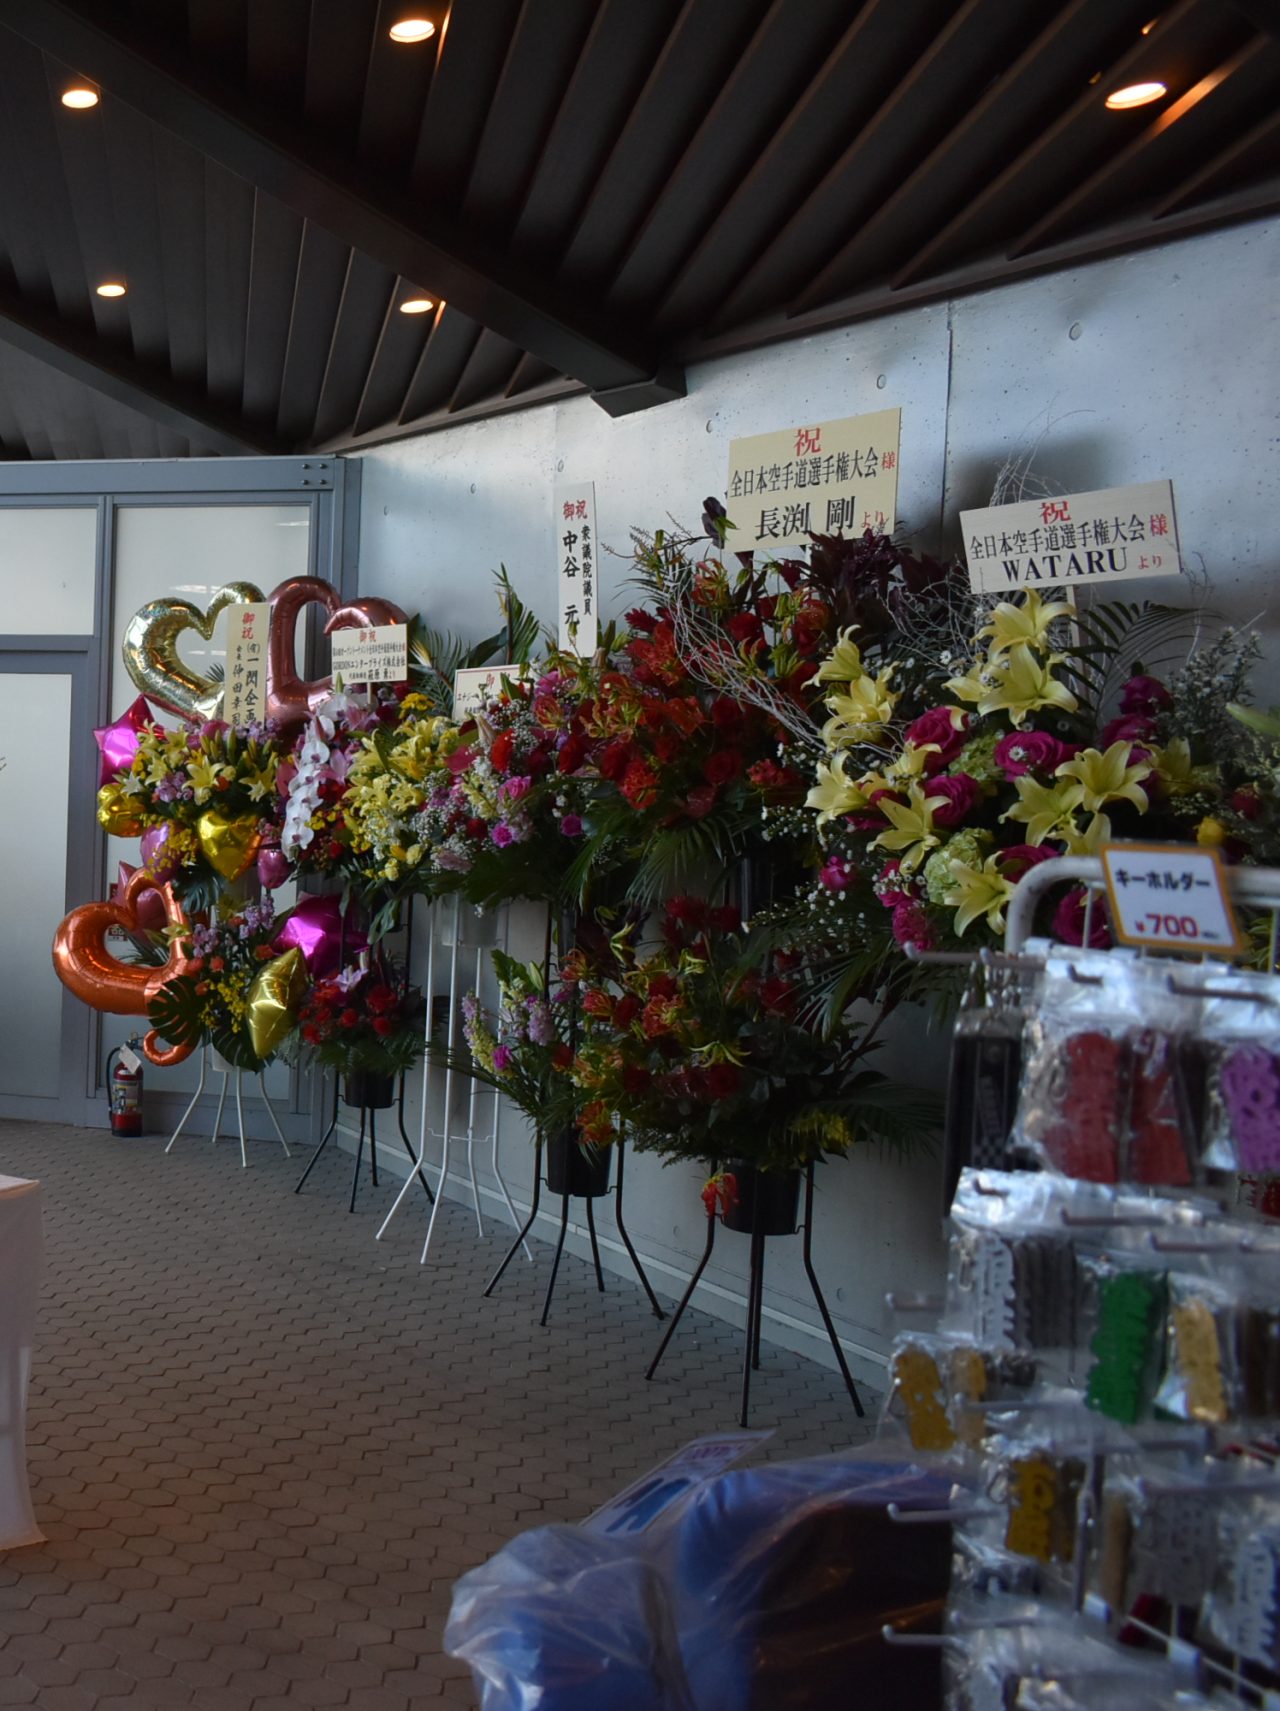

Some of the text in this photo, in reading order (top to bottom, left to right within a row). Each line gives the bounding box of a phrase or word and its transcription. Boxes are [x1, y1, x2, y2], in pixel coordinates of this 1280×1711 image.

[794, 427, 822, 457] 祝
[731, 446, 897, 498] 全日本空手道選手権大会 様
[563, 500, 588, 521] 御祝
[755, 496, 886, 542] 長渕 剛 より
[1038, 500, 1072, 525] 祝
[970, 513, 1168, 560] 全日本空手道選手権大会 様
[562, 530, 581, 627] 中谷 元
[581, 525, 593, 616] 衆議院議員
[1002, 546, 1163, 583] WATARU より
[241, 612, 255, 640] 御祝
[359, 629, 377, 643] 御祝
[1115, 868, 1210, 891] キーホルダー
[1135, 912, 1198, 938] ¥700
